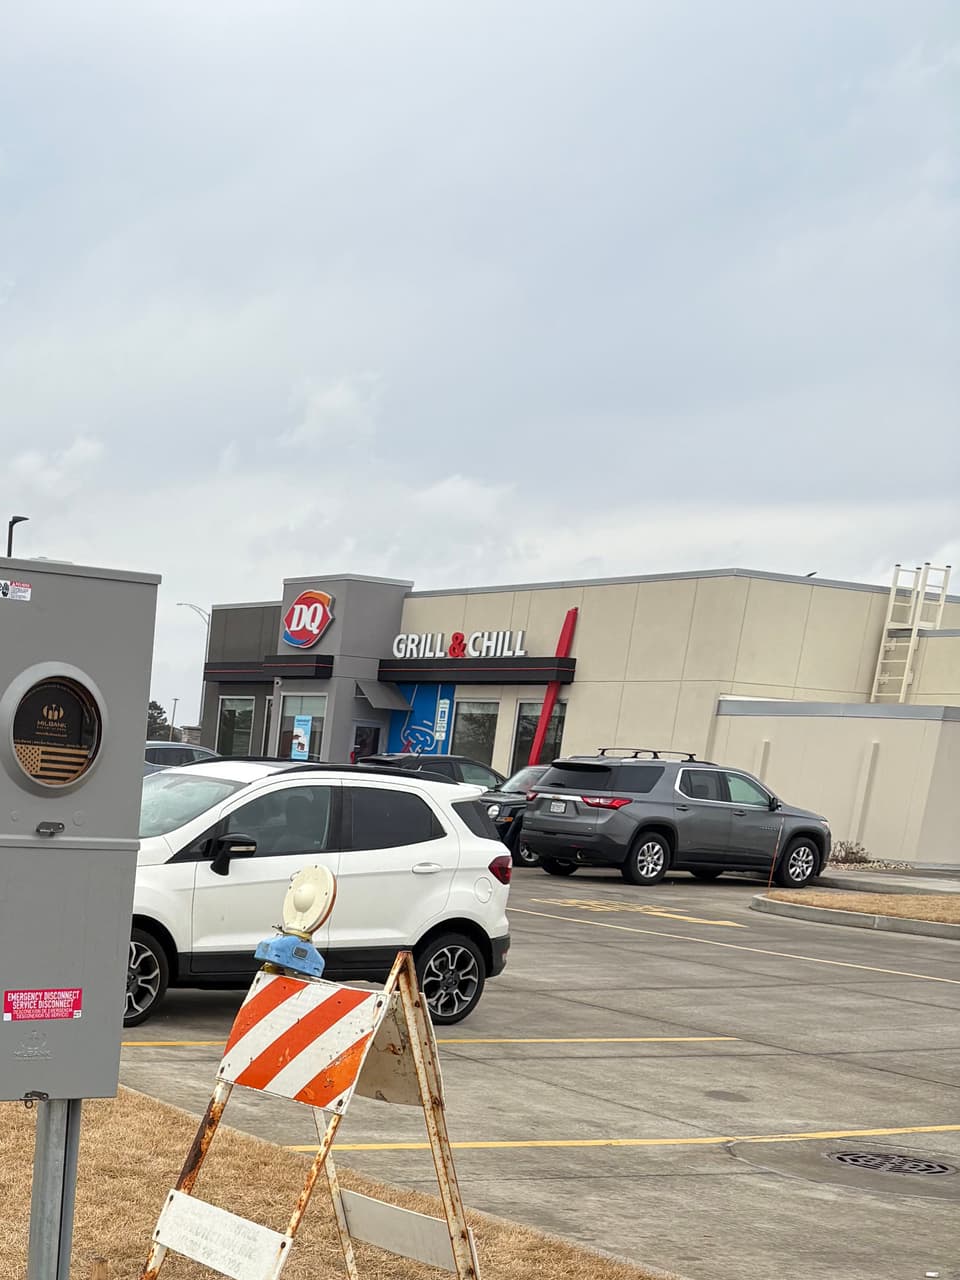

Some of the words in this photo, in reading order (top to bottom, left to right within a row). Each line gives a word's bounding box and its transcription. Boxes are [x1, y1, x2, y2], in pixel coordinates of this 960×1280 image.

[290, 603, 324, 634] DQ
[393, 633, 446, 658] GRILL
[448, 632, 467, 657] &
[468, 630, 527, 657] CHILL
[37, 720, 67, 729] MILBANK
[7, 992, 43, 1001] EMERGENCY
[44, 991, 80, 1000] DISCONNECT
[13, 1001, 37, 1009] SERVICE
[38, 1000, 74, 1008] DISCONNECT
